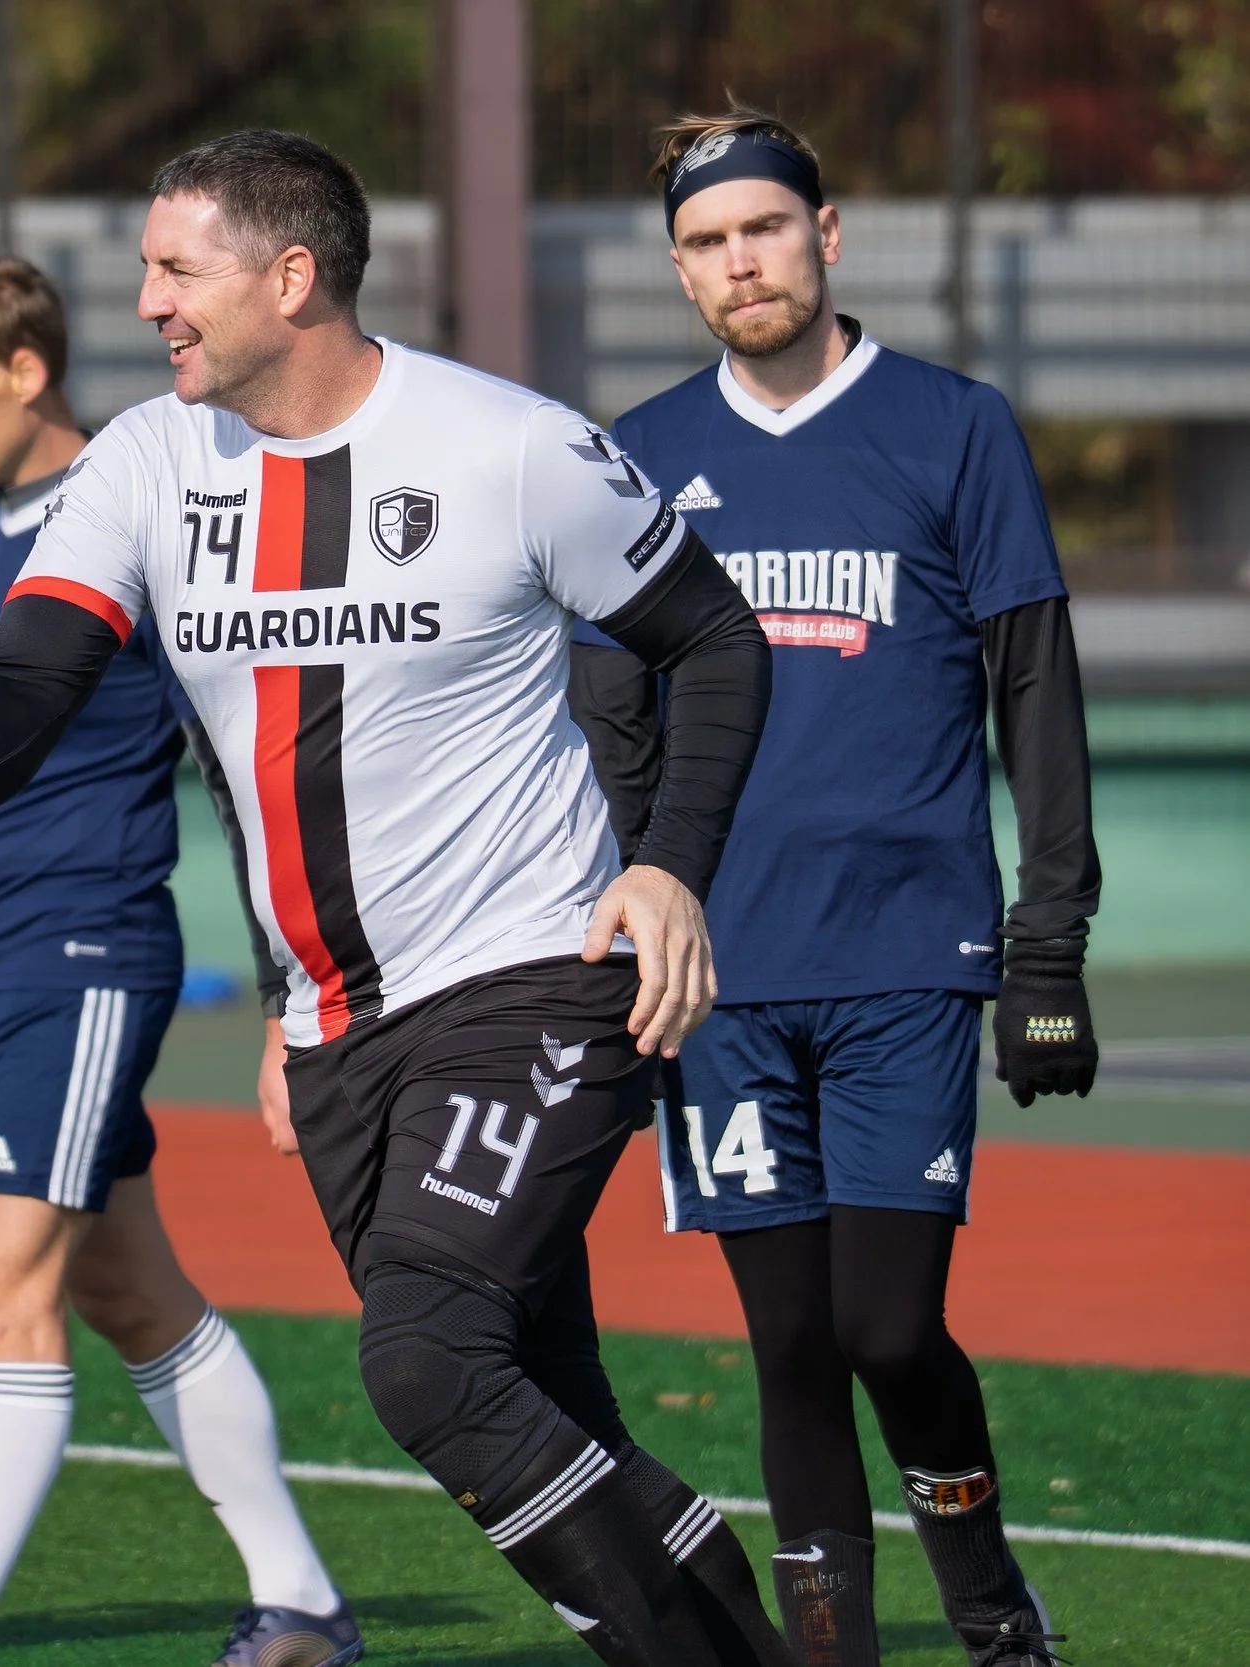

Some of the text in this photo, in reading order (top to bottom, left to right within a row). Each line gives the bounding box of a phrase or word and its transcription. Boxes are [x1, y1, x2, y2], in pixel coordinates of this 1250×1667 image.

[185, 488, 247, 508] hummel
[671, 496, 720, 511] adidas
[183, 512, 244, 585] 14
[382, 527, 428, 537] UNITED
[631, 504, 673, 564] RESPECT
[713, 550, 896, 627] ARDIAN
[176, 602, 440, 653] GUARDIANS
[760, 621, 856, 640] OTBALL CLUB
[434, 1093, 540, 1199] 14
[681, 1100, 778, 1198] 14
[420, 1172, 500, 1216] hummel
[924, 1169, 959, 1183] adidas
